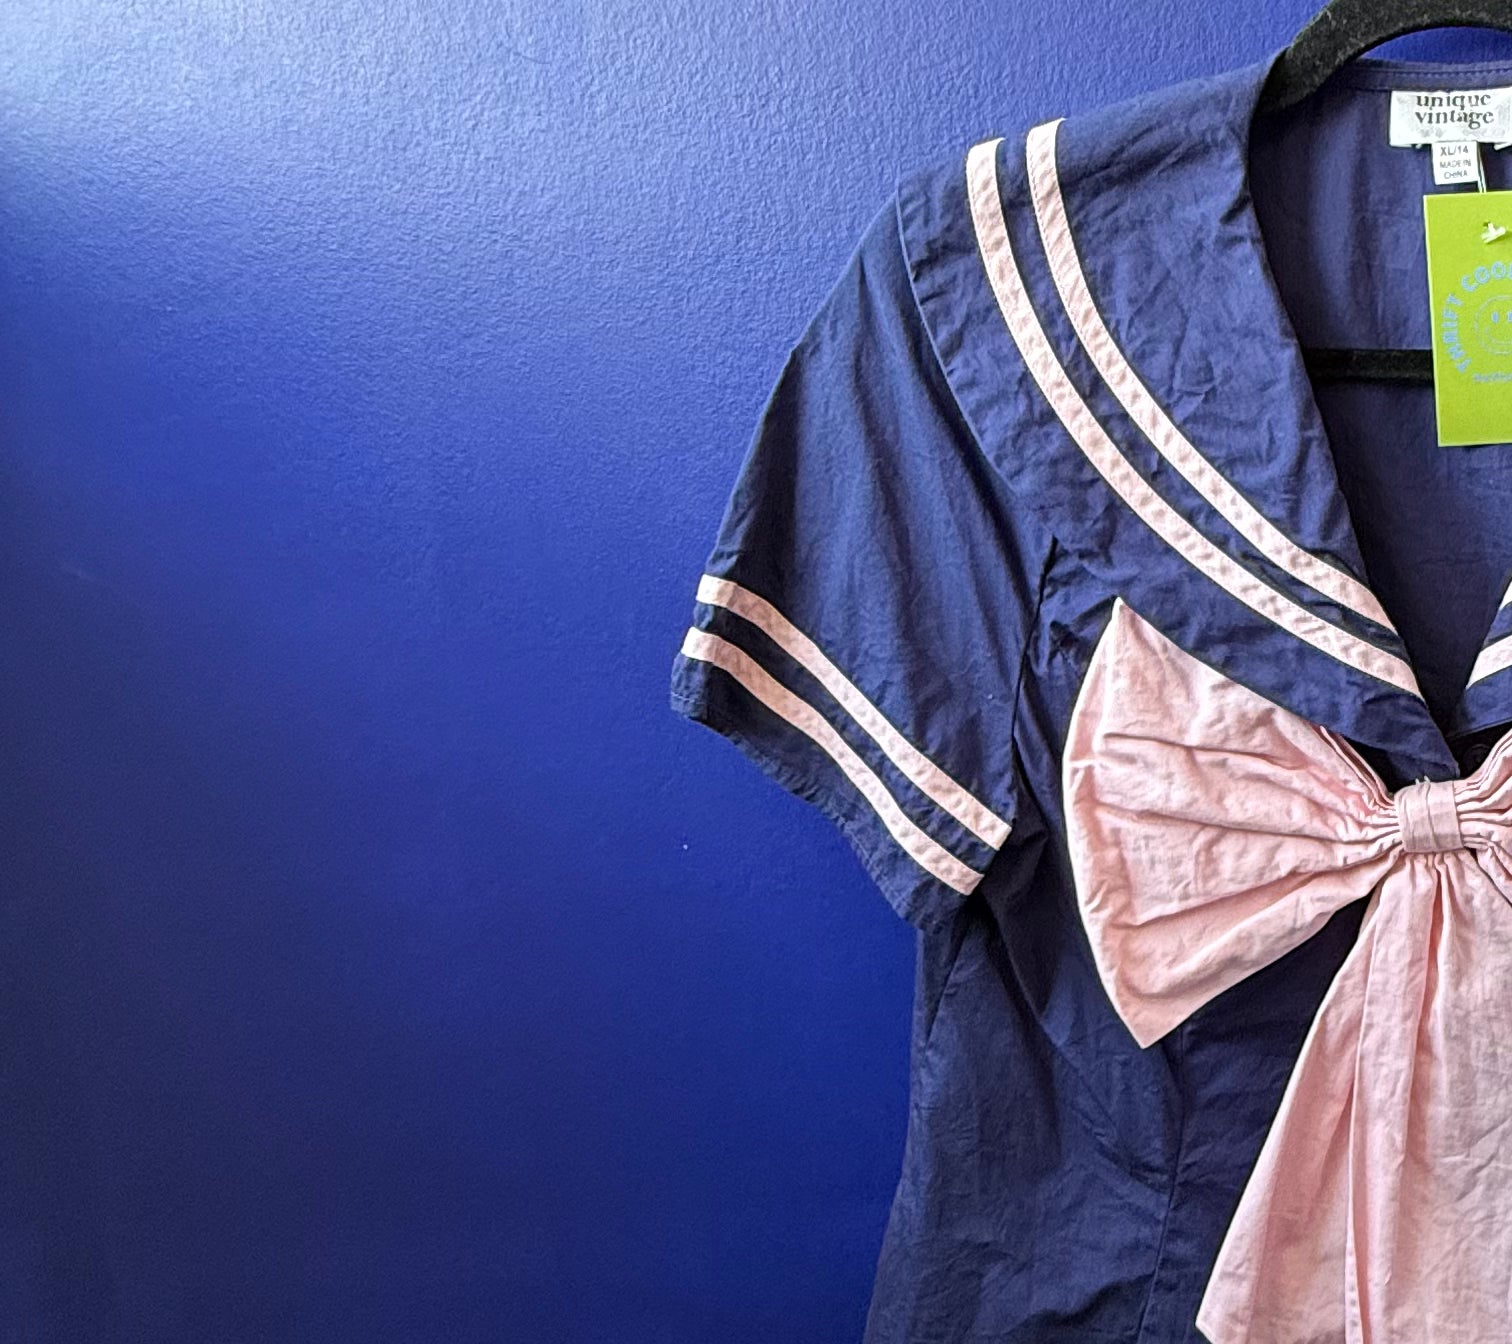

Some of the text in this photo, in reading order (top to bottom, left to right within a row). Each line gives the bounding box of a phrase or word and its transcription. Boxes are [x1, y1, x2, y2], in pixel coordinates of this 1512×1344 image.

[1416, 93, 1491, 111] unique
[1415, 107, 1494, 130] vintage
[1441, 292, 1472, 373] THRIFT
